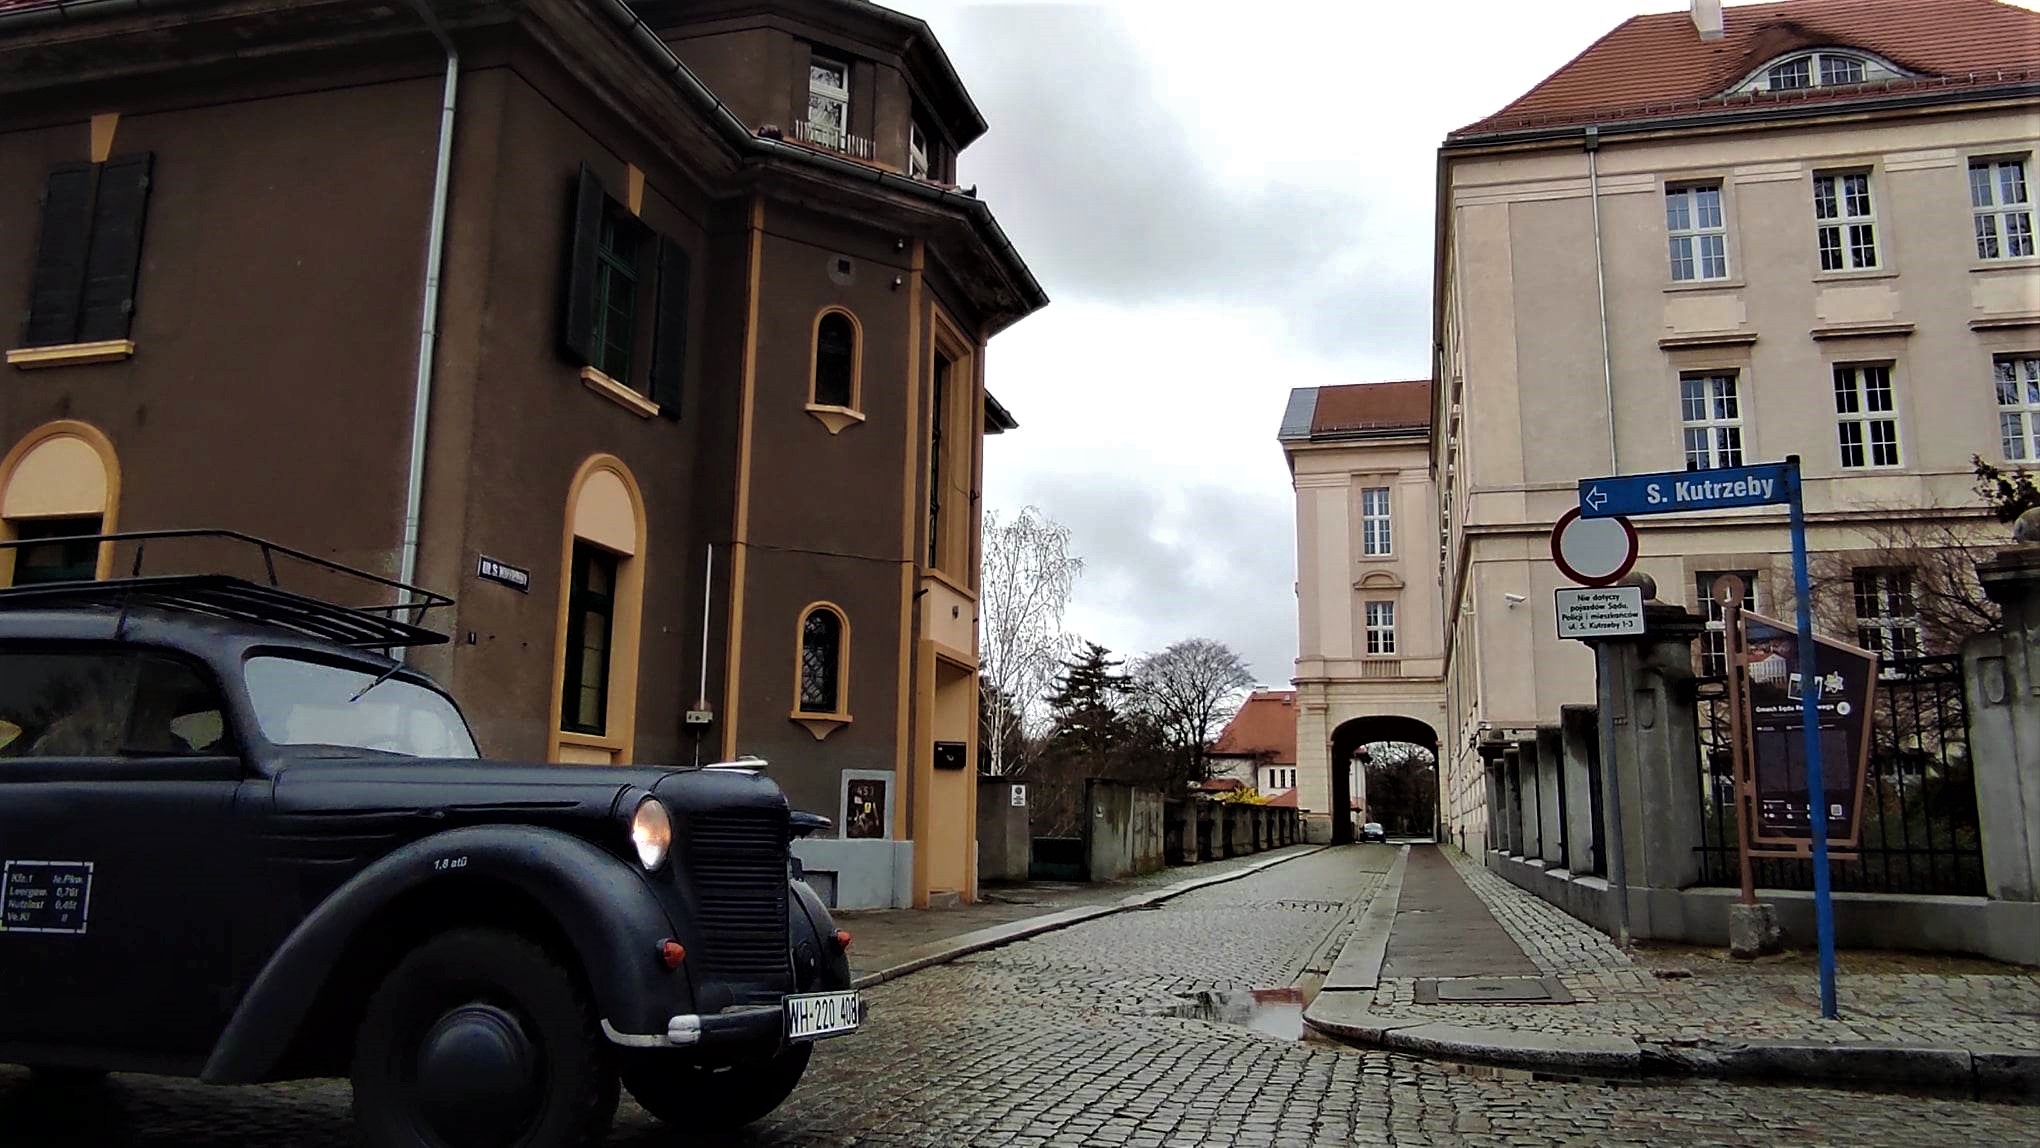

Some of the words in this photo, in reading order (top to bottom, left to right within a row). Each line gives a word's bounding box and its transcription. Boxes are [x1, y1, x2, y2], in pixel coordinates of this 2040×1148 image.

[1647, 484, 1668, 503] S.
[1675, 476, 1775, 504] Kutrzeby
[1593, 594, 1620, 602] dotyczy
[1570, 604, 1605, 612] pojazdów
[1562, 613, 1583, 622] Policji
[1590, 622, 1620, 631] Kutrzeby
[841, 996, 858, 1026] 408
